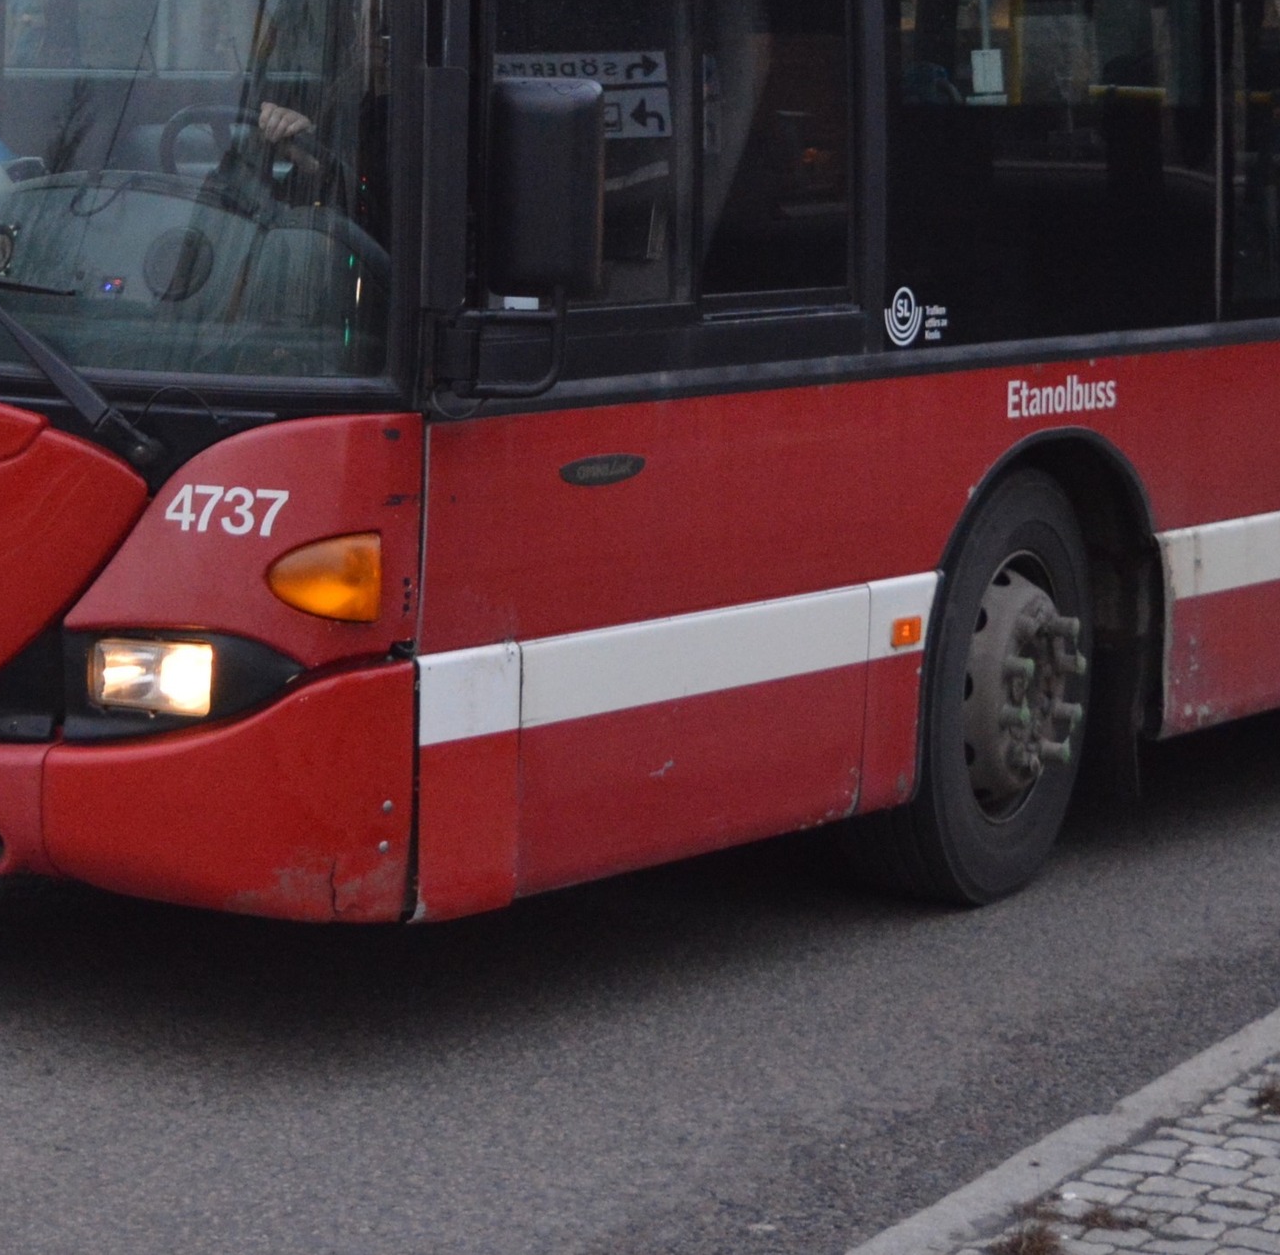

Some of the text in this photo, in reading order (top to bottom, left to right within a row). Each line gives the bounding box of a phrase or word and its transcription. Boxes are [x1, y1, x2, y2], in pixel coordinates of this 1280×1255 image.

[896, 299, 910, 318] SL
[1007, 374, 1116, 418] Etanolbuss
[165, 484, 290, 536] 4737
